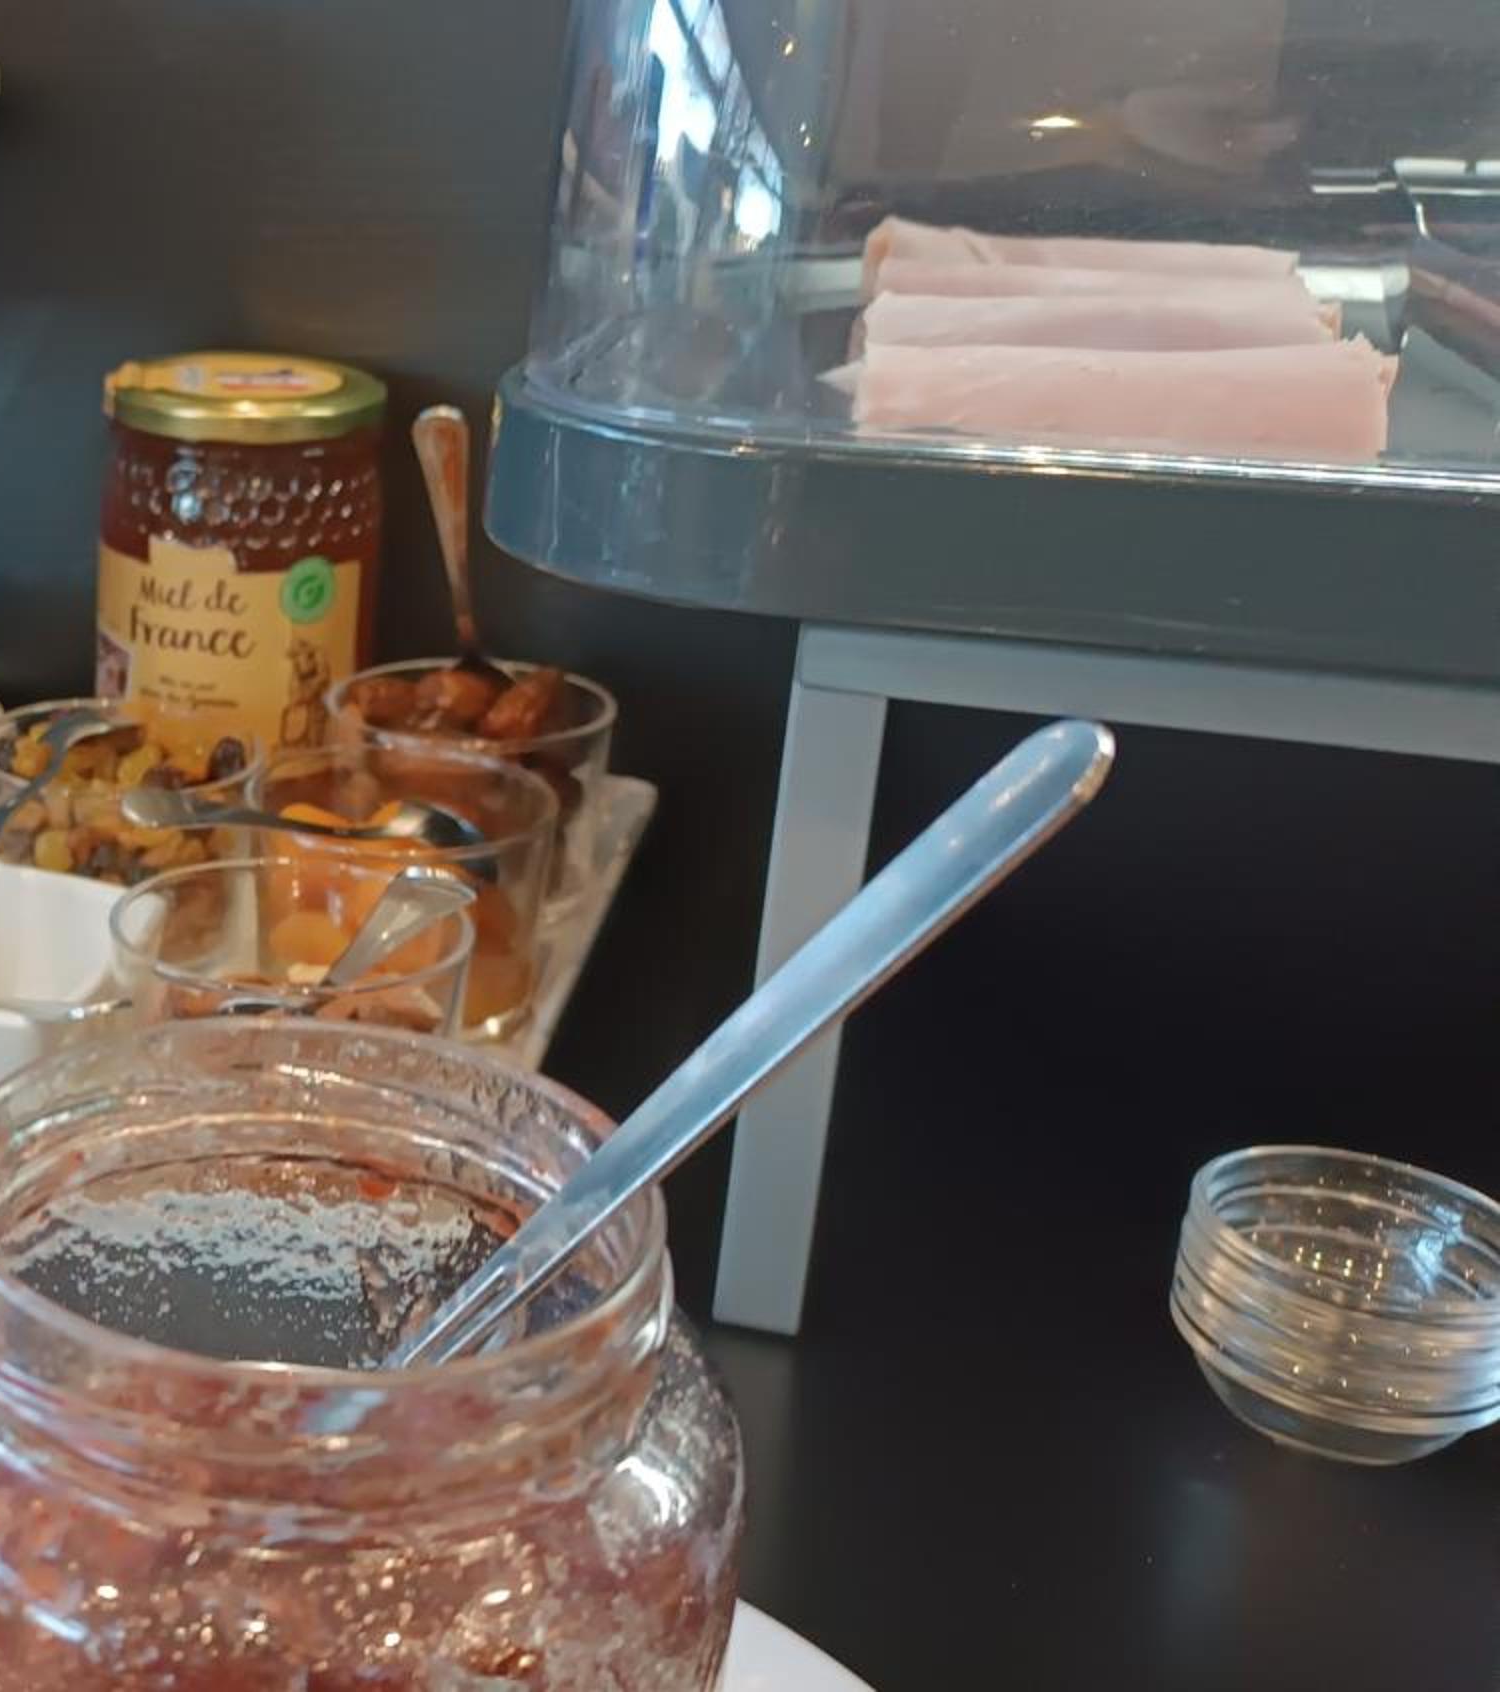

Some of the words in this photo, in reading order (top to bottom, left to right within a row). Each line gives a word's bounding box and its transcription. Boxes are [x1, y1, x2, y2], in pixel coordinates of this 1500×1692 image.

[139, 574, 197, 610] Miel
[205, 579, 250, 616] de
[129, 605, 257, 660] France
